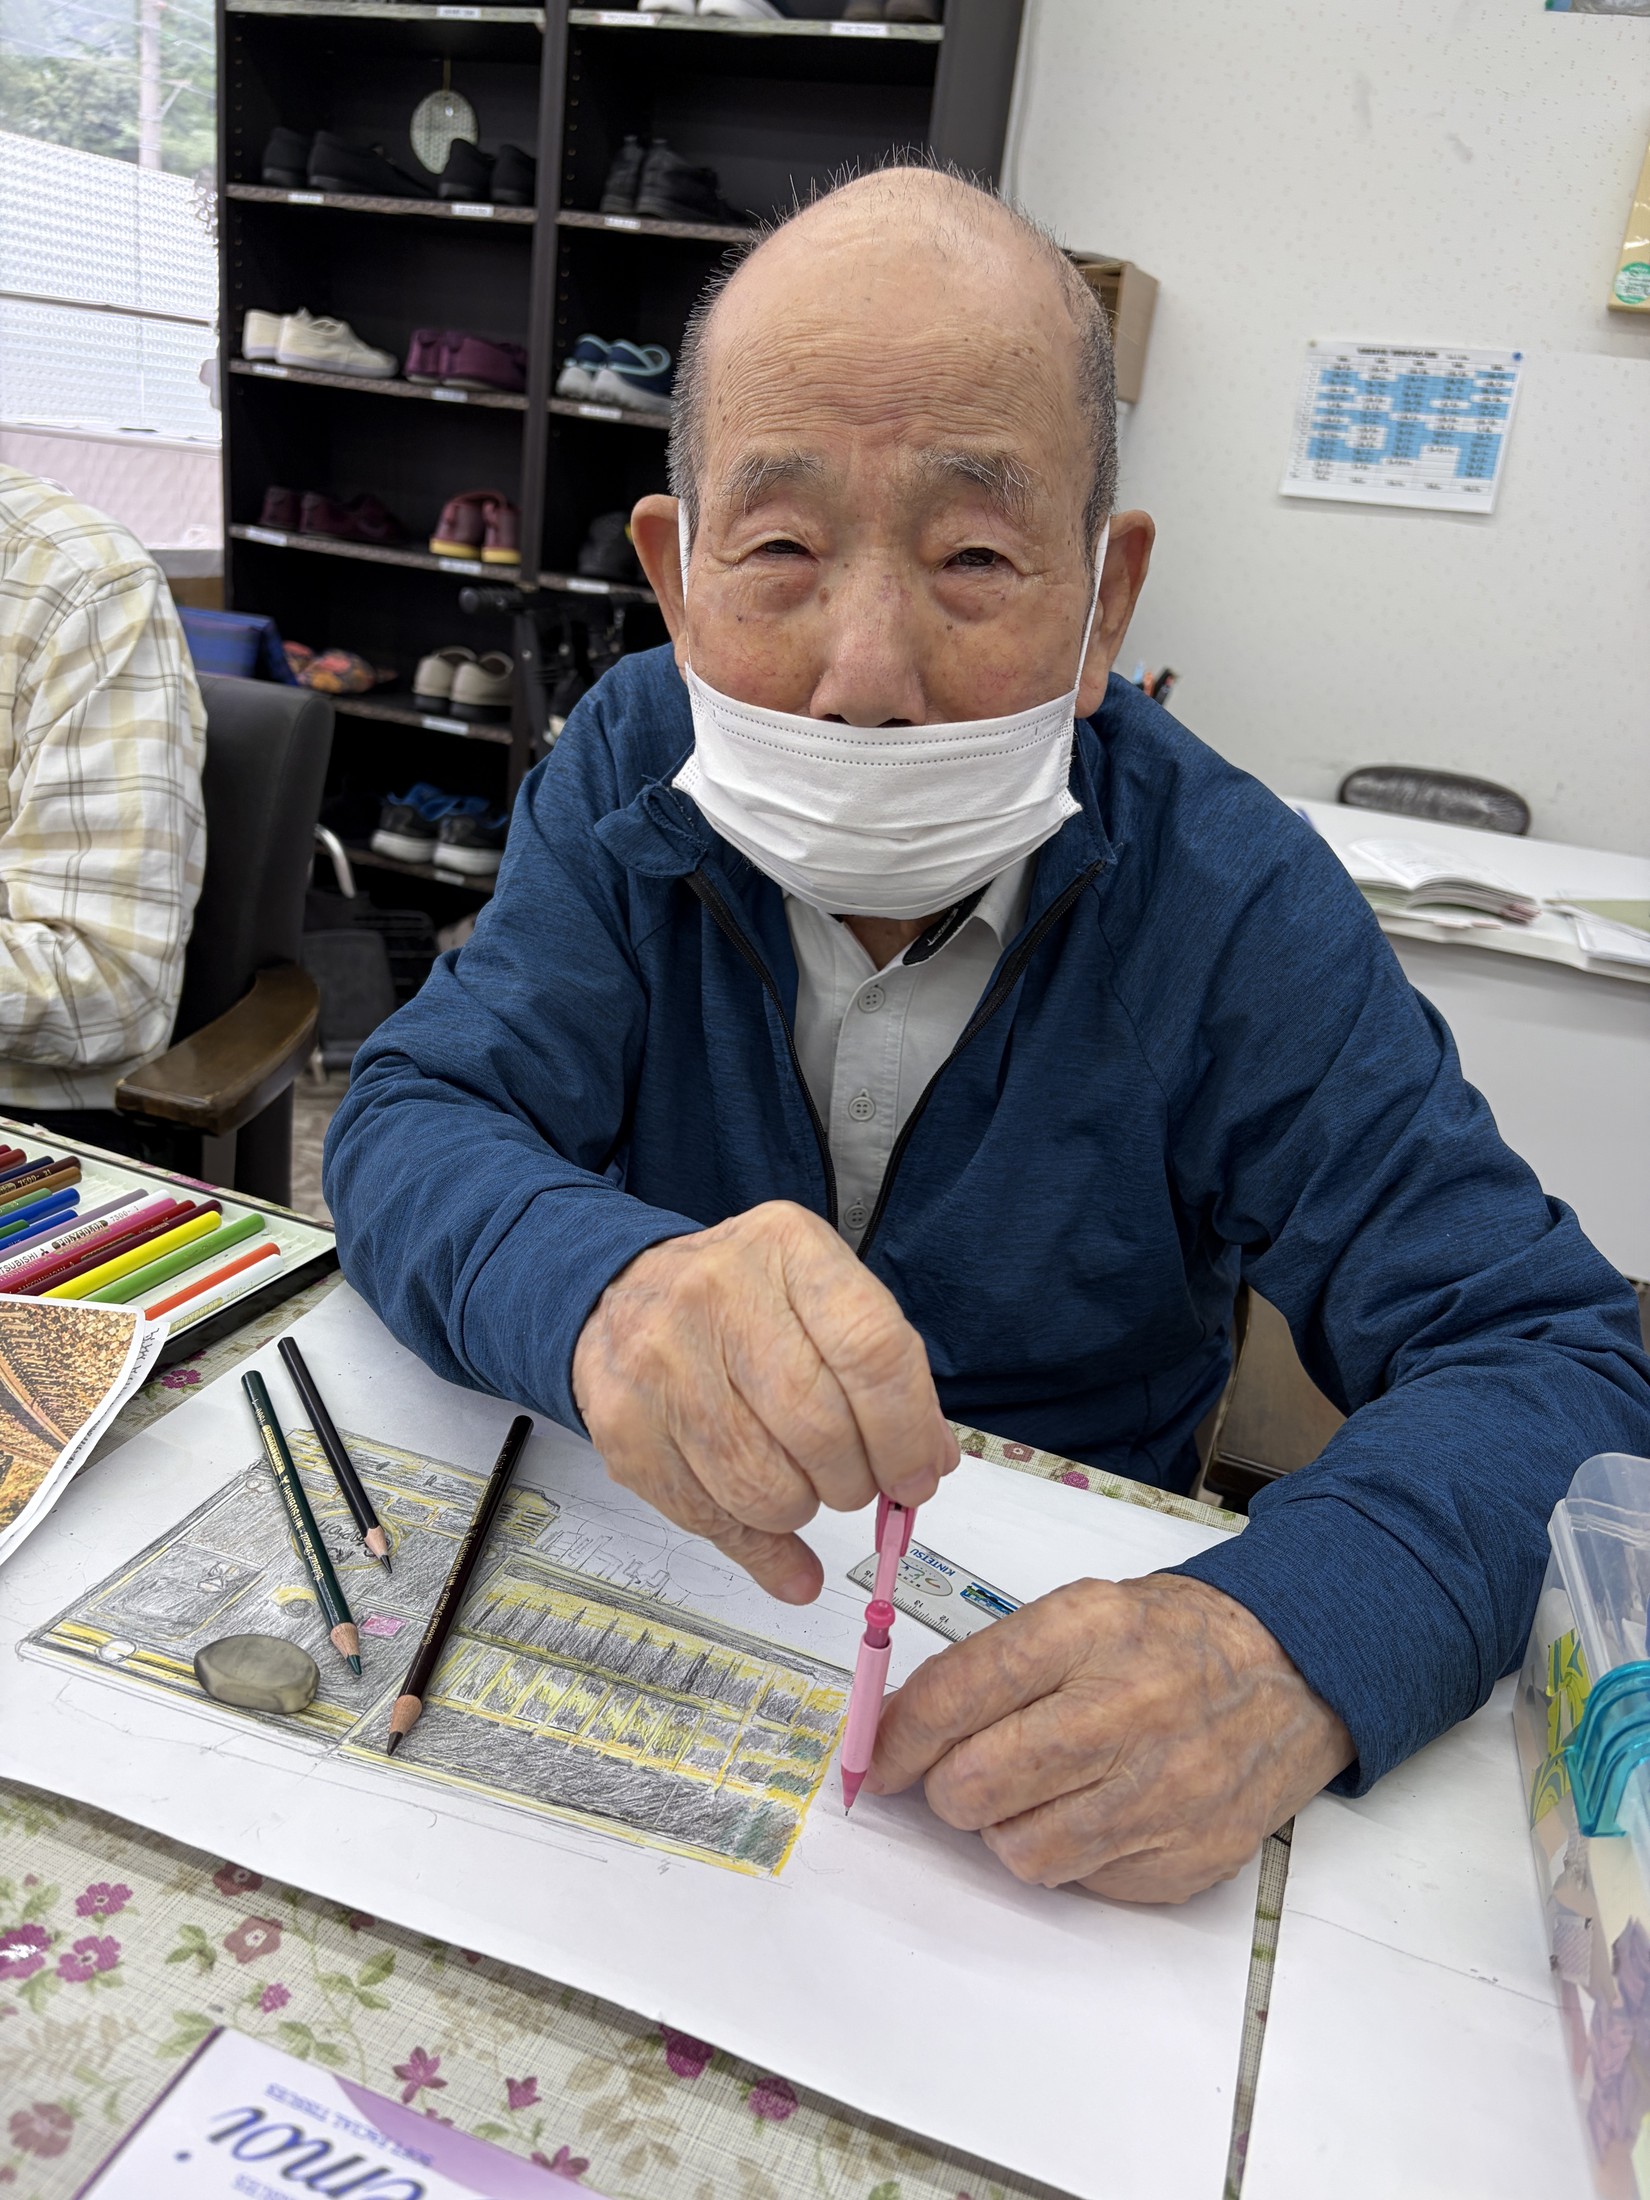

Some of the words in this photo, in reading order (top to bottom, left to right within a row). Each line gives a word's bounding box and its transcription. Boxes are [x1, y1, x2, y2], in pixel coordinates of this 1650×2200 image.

[0, 1252, 38, 1275] TSUBISHI
[57, 1221, 104, 1247] POLYCOLOR
[283, 1485, 304, 1532] MITSUBISHI
[910, 1548, 956, 1577] KINTETSU
[913, 1599, 924, 1609] 13
[939, 1614, 950, 1623] 12
